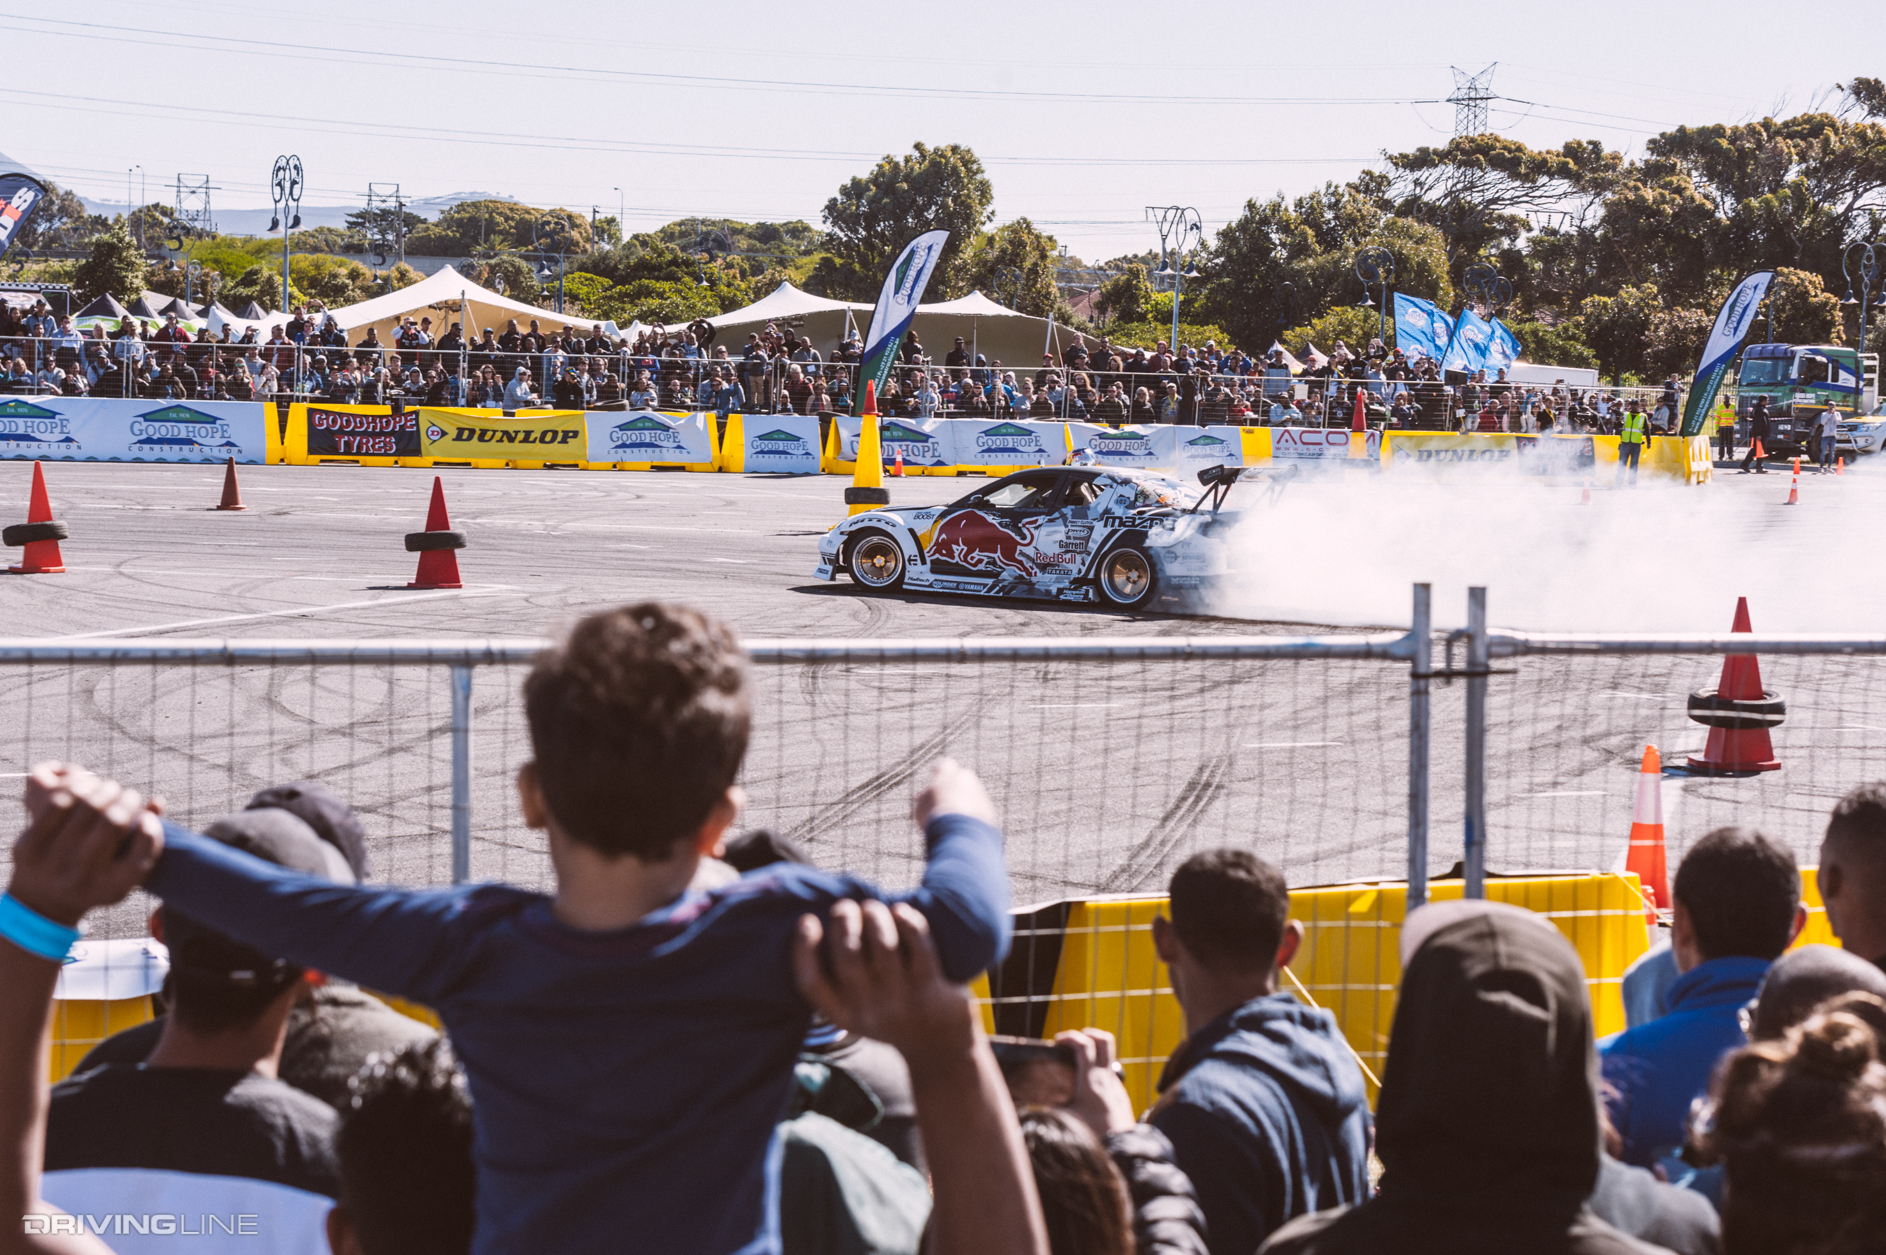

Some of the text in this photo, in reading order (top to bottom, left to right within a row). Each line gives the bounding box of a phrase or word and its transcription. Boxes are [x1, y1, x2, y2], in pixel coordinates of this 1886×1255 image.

[893, 240, 928, 306] GOOD HOPE
[1721, 281, 1754, 338] GOOD HOPE
[23, 418, 70, 439] HOPE
[312, 411, 416, 432] GOODHOPE
[129, 423, 231, 439] GOOD HOPE
[451, 426, 579, 444] DUNLOP
[609, 430, 680, 444] GOOD HOPE
[333, 434, 395, 453] TYRES
[751, 440, 808, 451] GOOD HOPE
[976, 435, 1042, 447] GOOD HOPE
[1089, 438, 1151, 450] GOOD HOPE
[1183, 442, 1232, 454] GOOD HOPE
[128, 446, 242, 454] CONSTRUCTION
[898, 441, 941, 458] HOPE
[1416, 449, 1511, 463] DUNLOP
[848, 517, 897, 528] NITTO
[1058, 539, 1084, 550] Garrett
[1035, 551, 1076, 565] Red Bull
